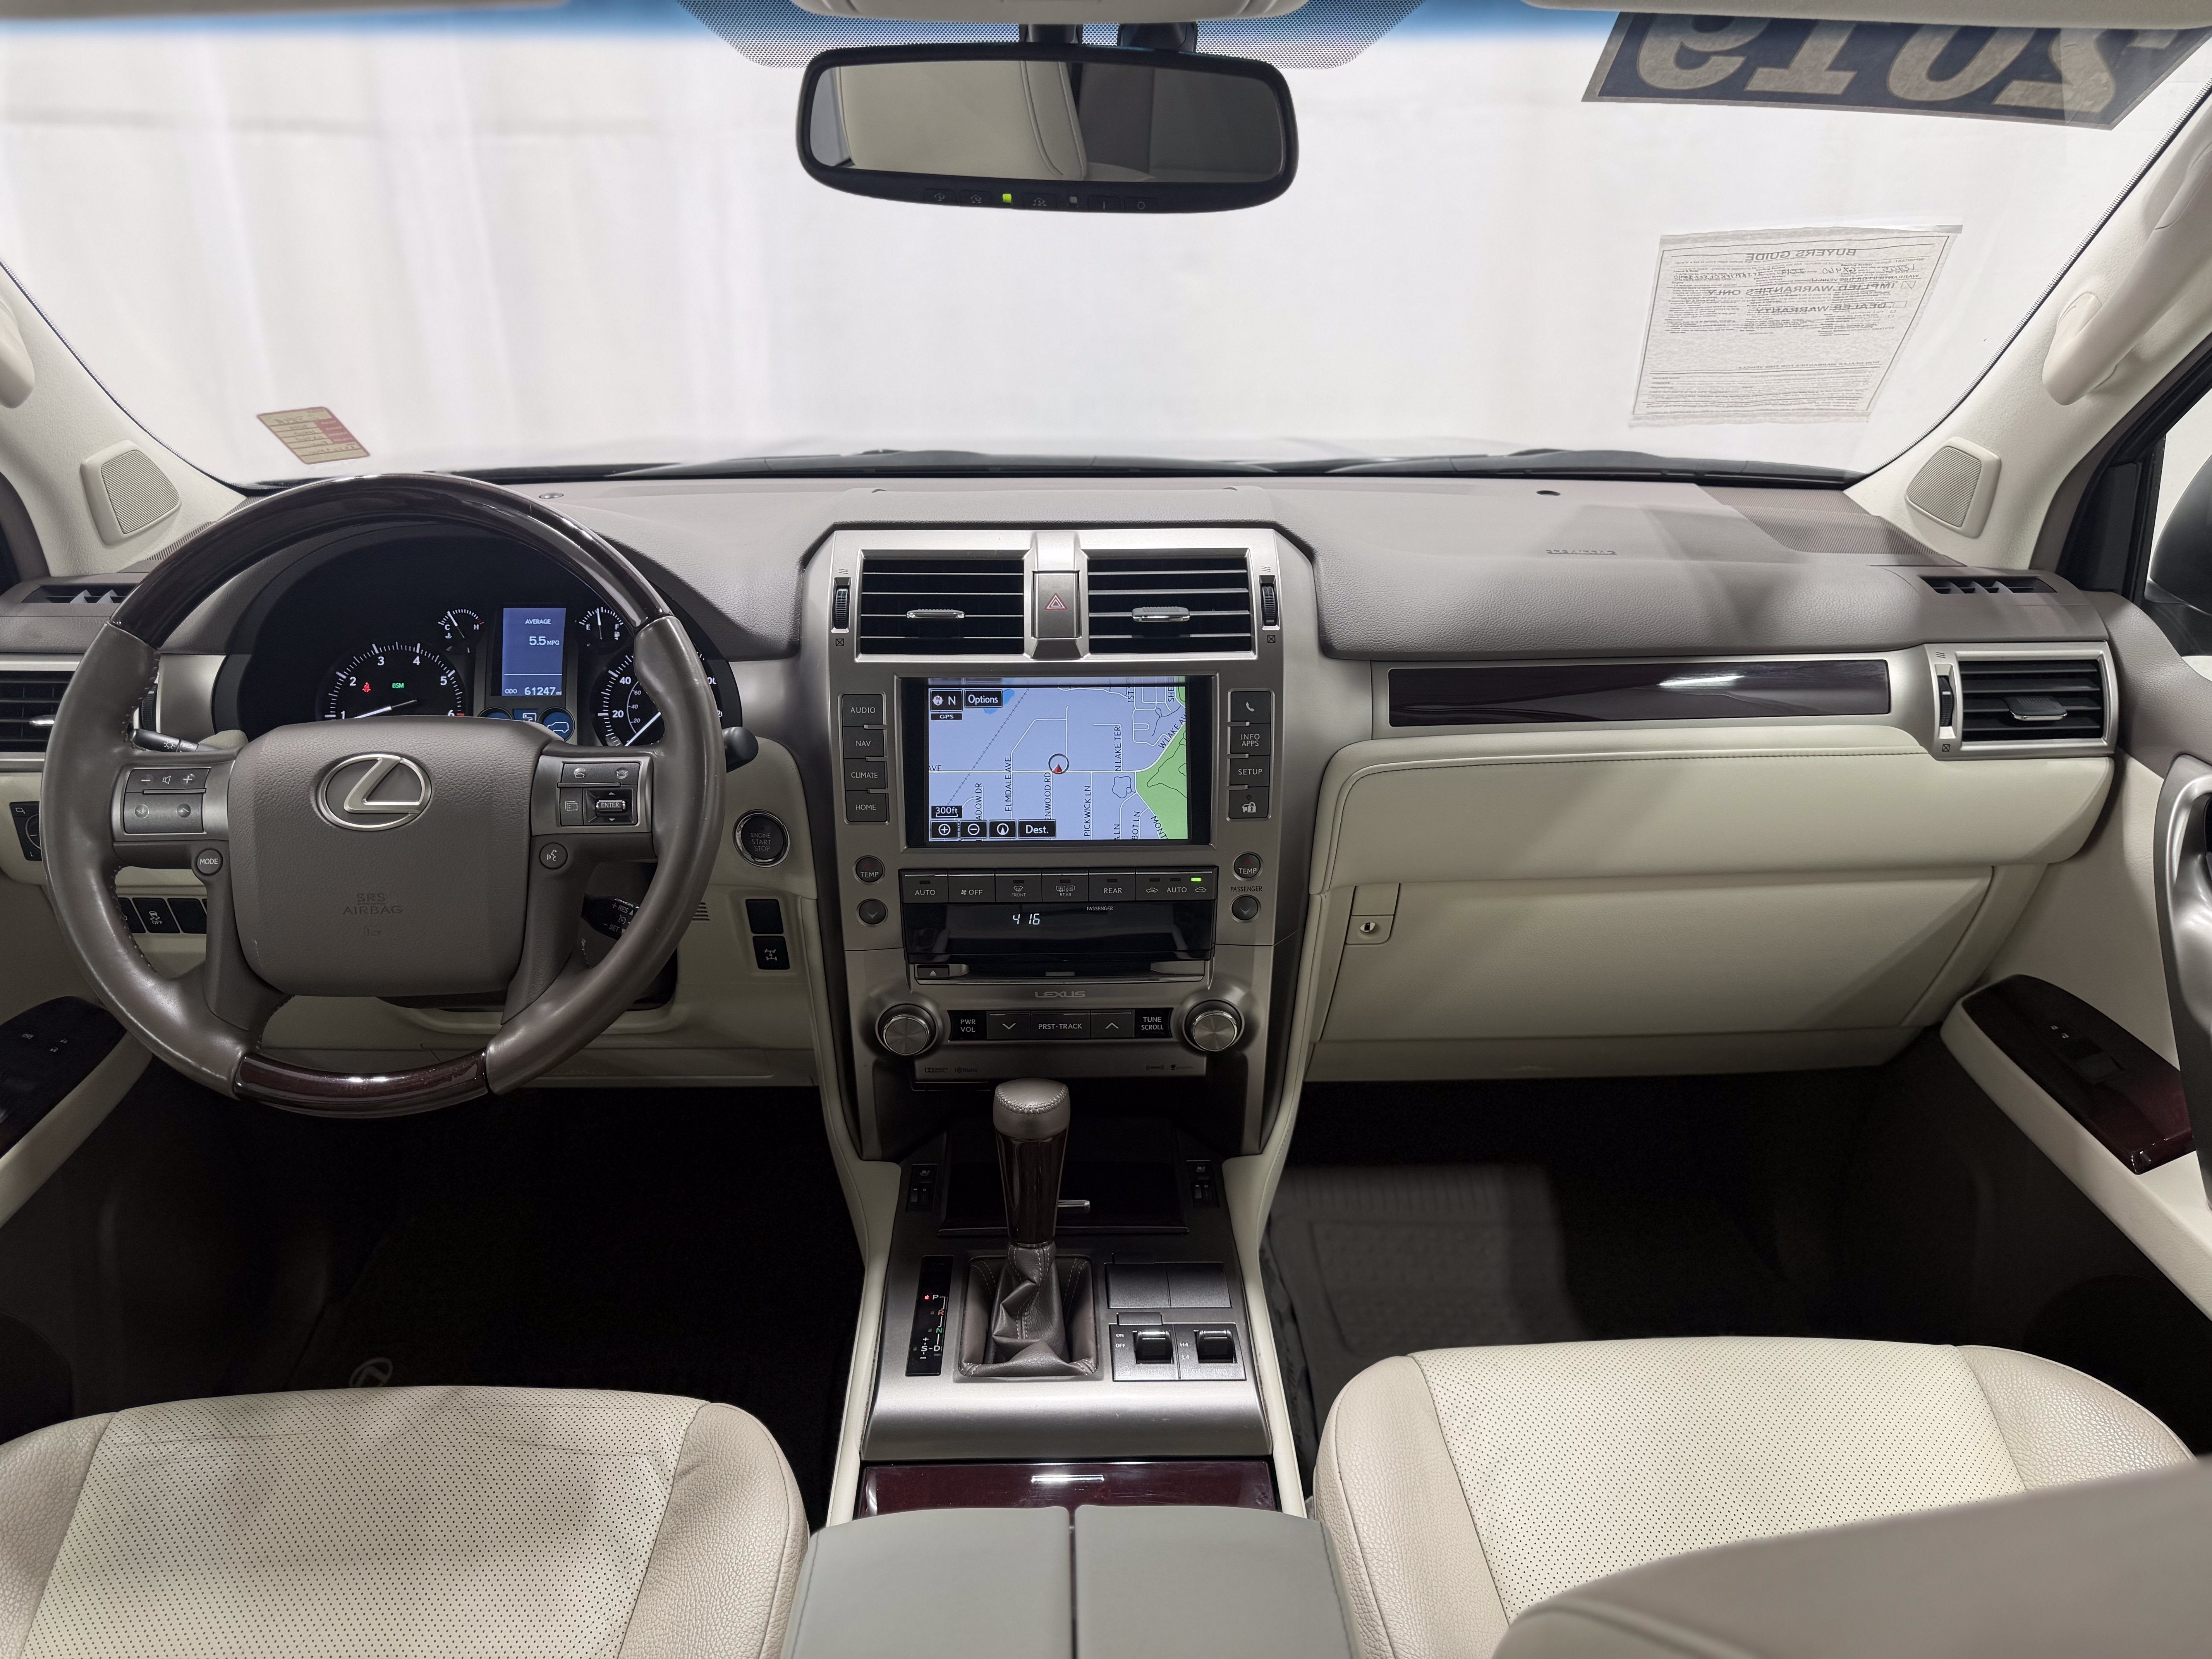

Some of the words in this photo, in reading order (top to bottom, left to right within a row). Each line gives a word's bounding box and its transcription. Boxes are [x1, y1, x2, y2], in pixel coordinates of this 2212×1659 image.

[529, 636, 546, 646] 5.5
[377, 656, 385, 666] 3
[412, 656, 420, 665] 4
[349, 677, 356, 686] 2
[440, 676, 447, 685] 5
[524, 687, 556, 696] 61247
[948, 696, 956, 705] N
[968, 694, 998, 705] Options
[341, 711, 345, 720] 1
[612, 710, 624, 718] 20
[1044, 772, 1051, 783] RD
[975, 783, 982, 794] DR
[1085, 786, 1091, 795] LN
[1134, 811, 1140, 821] LN
[1025, 825, 1049, 834] Dest.
[357, 893, 385, 902] SRS
[343, 905, 403, 914] AIRBAG
[618, 905, 629, 913] RES
[609, 924, 620, 932] SET
